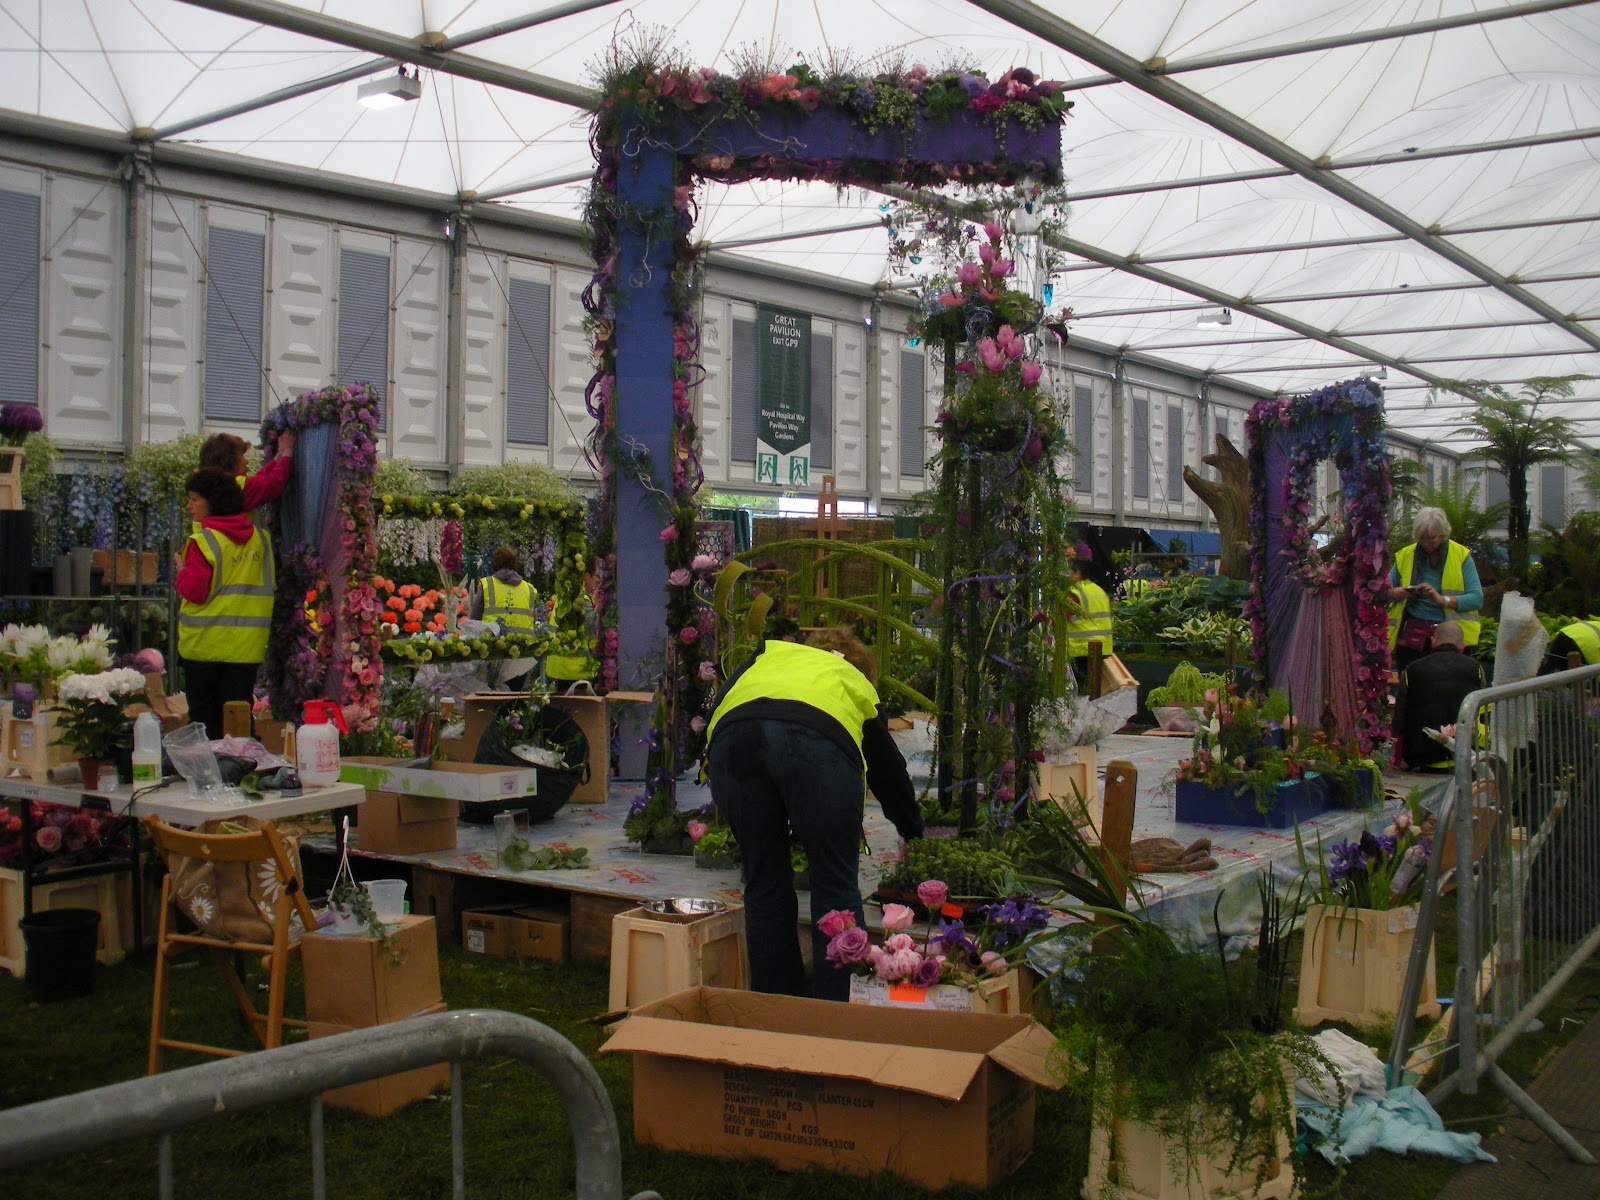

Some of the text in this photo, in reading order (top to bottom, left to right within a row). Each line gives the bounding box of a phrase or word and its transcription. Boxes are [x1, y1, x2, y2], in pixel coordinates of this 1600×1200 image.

[774, 314, 796, 326] GREAT
[769, 323, 800, 337] PAVILION
[772, 336, 799, 348] EXIT GP9
[761, 409, 805, 423] Royal Hospital Way
[769, 420, 799, 433] Pavilion Way
[774, 431, 794, 440] Gardens
[723, 1102, 736, 1113] PO
[786, 1100, 803, 1112] PCS
[723, 1113, 746, 1126] GROSS
[801, 1124, 819, 1136] KGS
[723, 1124, 741, 1136] SIZE
[744, 1128, 755, 1138] OF
